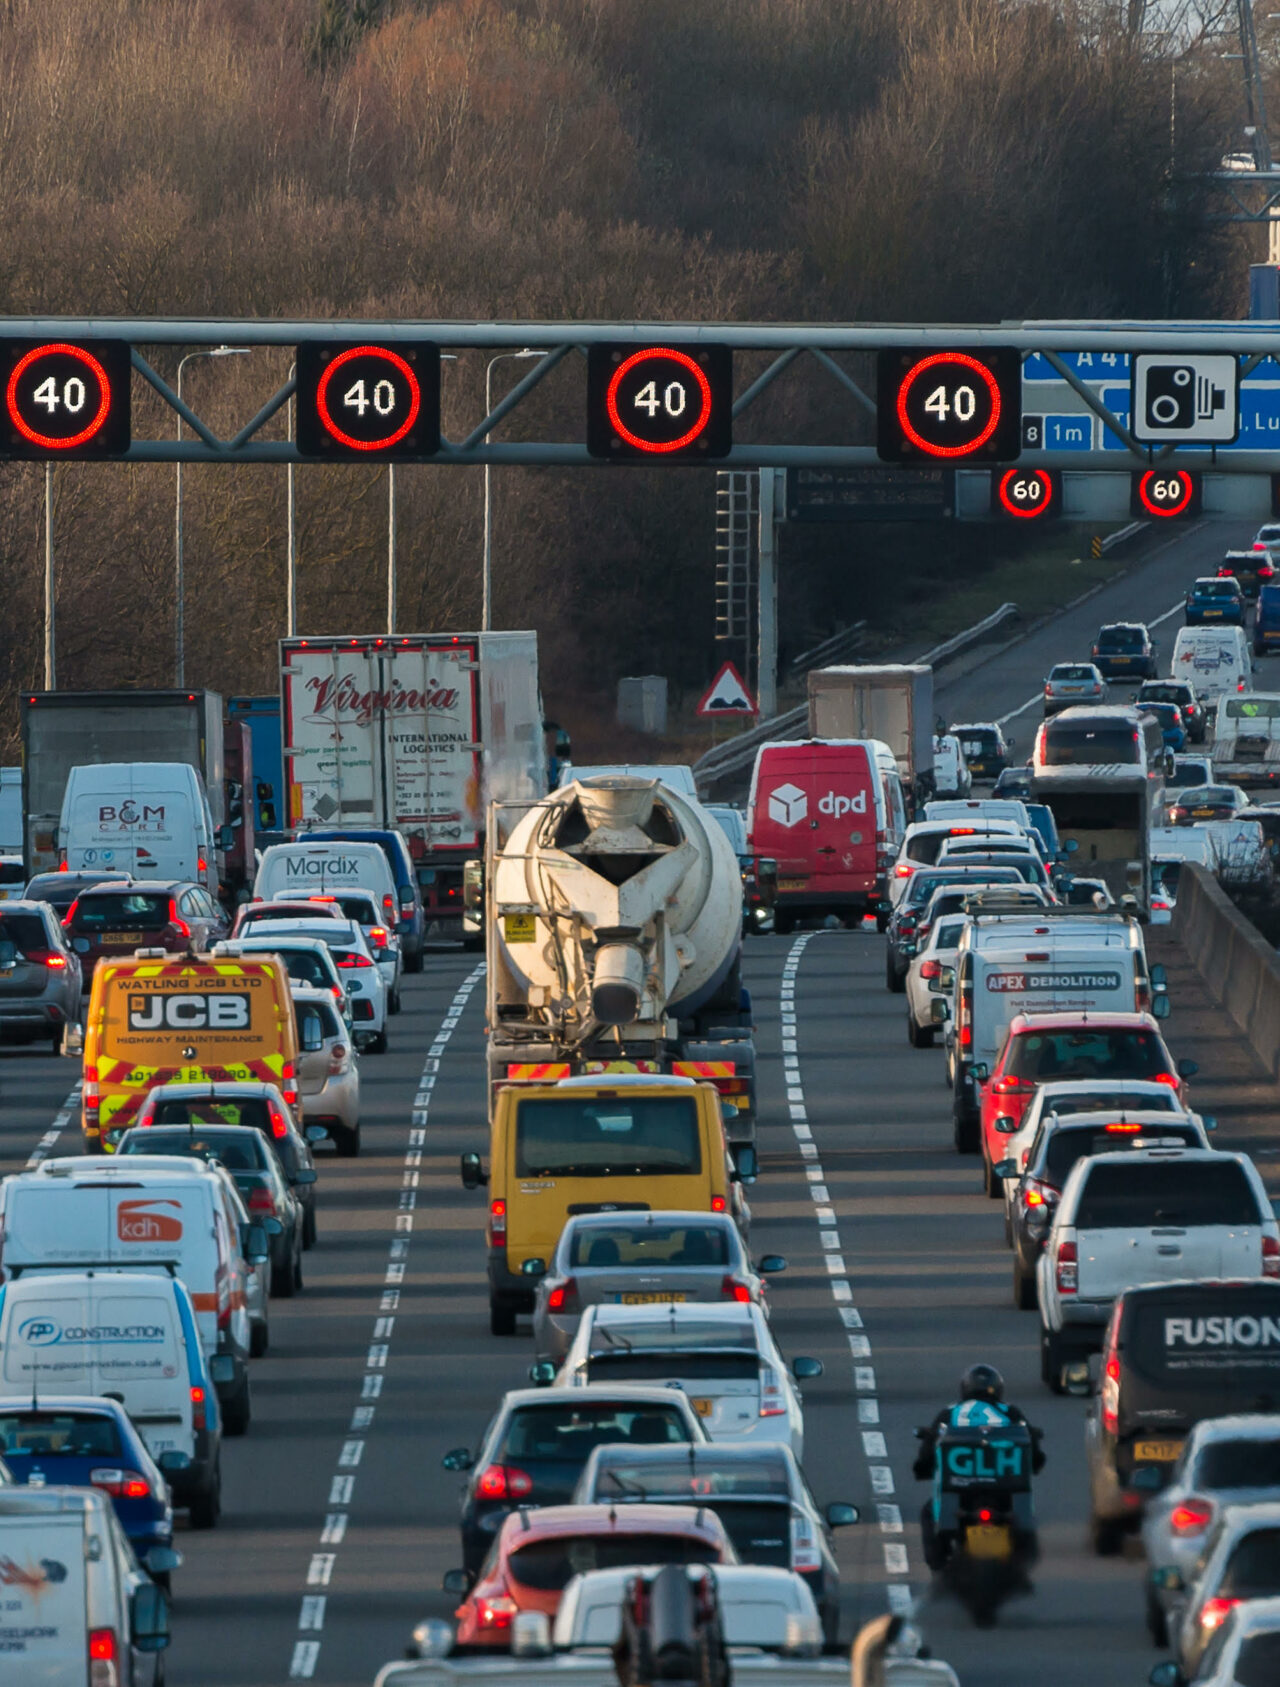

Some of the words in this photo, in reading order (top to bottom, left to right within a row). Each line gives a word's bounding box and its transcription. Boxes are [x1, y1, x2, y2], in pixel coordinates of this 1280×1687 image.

[32, 376, 86, 414] 40
[342, 378, 395, 416] 40
[633, 380, 687, 417] 40
[923, 385, 976, 421] 40
[1027, 427, 1038, 442] 8
[1013, 479, 1041, 500] 60
[1153, 479, 1181, 500] 60
[305, 673, 458, 727] Virginia
[403, 744, 455, 754] LOGISTICS
[818, 789, 866, 819] dpd
[286, 855, 359, 876] Mardix
[117, 979, 190, 990] WATLING
[194, 978, 226, 988] JCB
[231, 978, 262, 988] LTD
[988, 975, 1025, 990] APEX
[1029, 975, 1117, 988] DEMOLITION
[130, 994, 249, 1029] JCB
[116, 1036, 173, 1044] HIGHWAY
[121, 1217, 160, 1238] kdh
[64, 1325, 165, 1340] CONSTRUCTION
[1164, 1316, 1280, 1347] FUSION
[947, 1445, 1022, 1477] GLH
